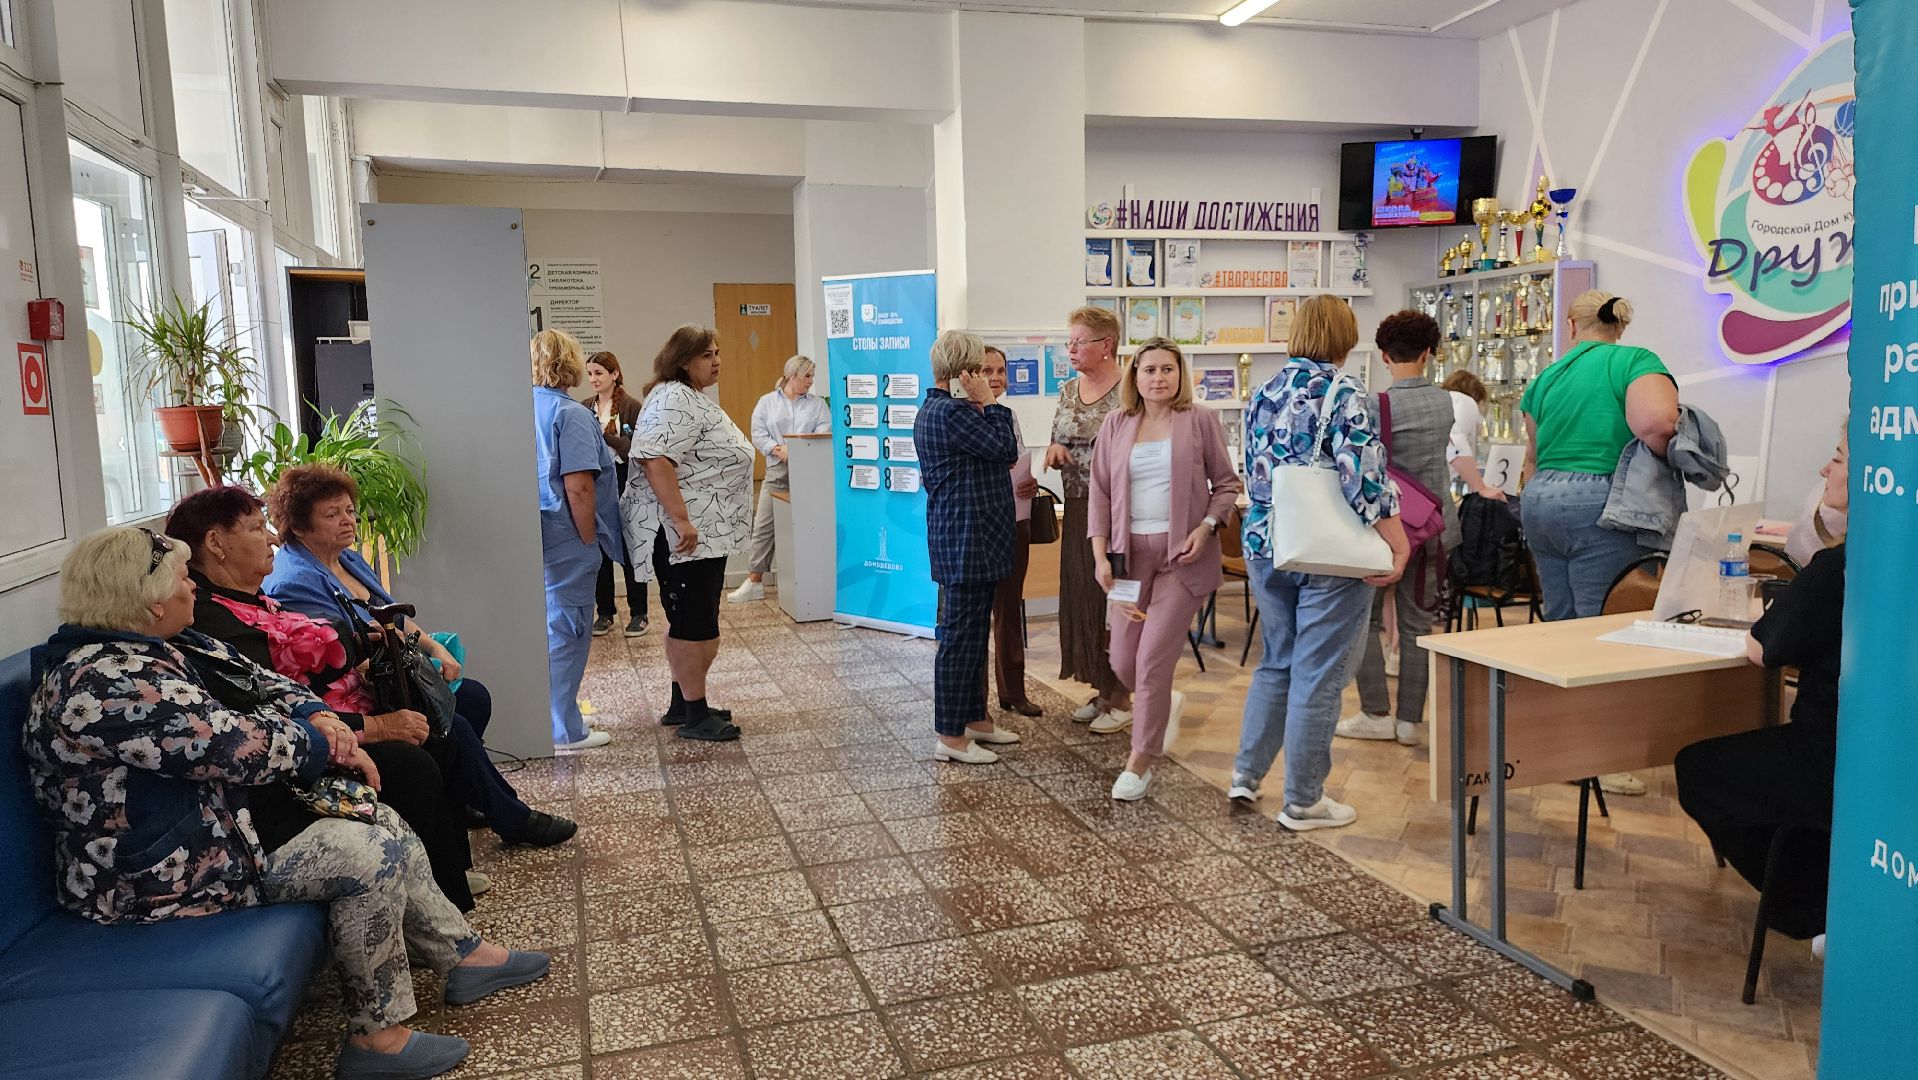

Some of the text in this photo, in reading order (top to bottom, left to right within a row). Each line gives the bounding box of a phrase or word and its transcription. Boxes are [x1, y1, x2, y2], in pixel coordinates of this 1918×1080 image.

[1117, 200, 1319, 232] #НАШИ ДОСТИЖЕНИЯ
[1751, 219, 1811, 235] Городской
[1814, 217, 1839, 232] Дом
[529, 264, 541, 279] 2
[1216, 271, 1288, 288] #ТВОРЧЕСТВО
[530, 306, 543, 332] 1
[852, 336, 910, 351] СТОЛЫ ЗАПИСИ
[843, 374, 848, 397] 1
[883, 374, 890, 398] 2
[843, 404, 852, 427] 3
[882, 405, 890, 424] 4
[846, 435, 853, 458] 5
[883, 436, 890, 459] 6
[847, 465, 854, 487] 7
[884, 467, 891, 489] 8
[1492, 458, 1509, 488] 3
[864, 560, 904, 571] ДОМОДЕДОВО
